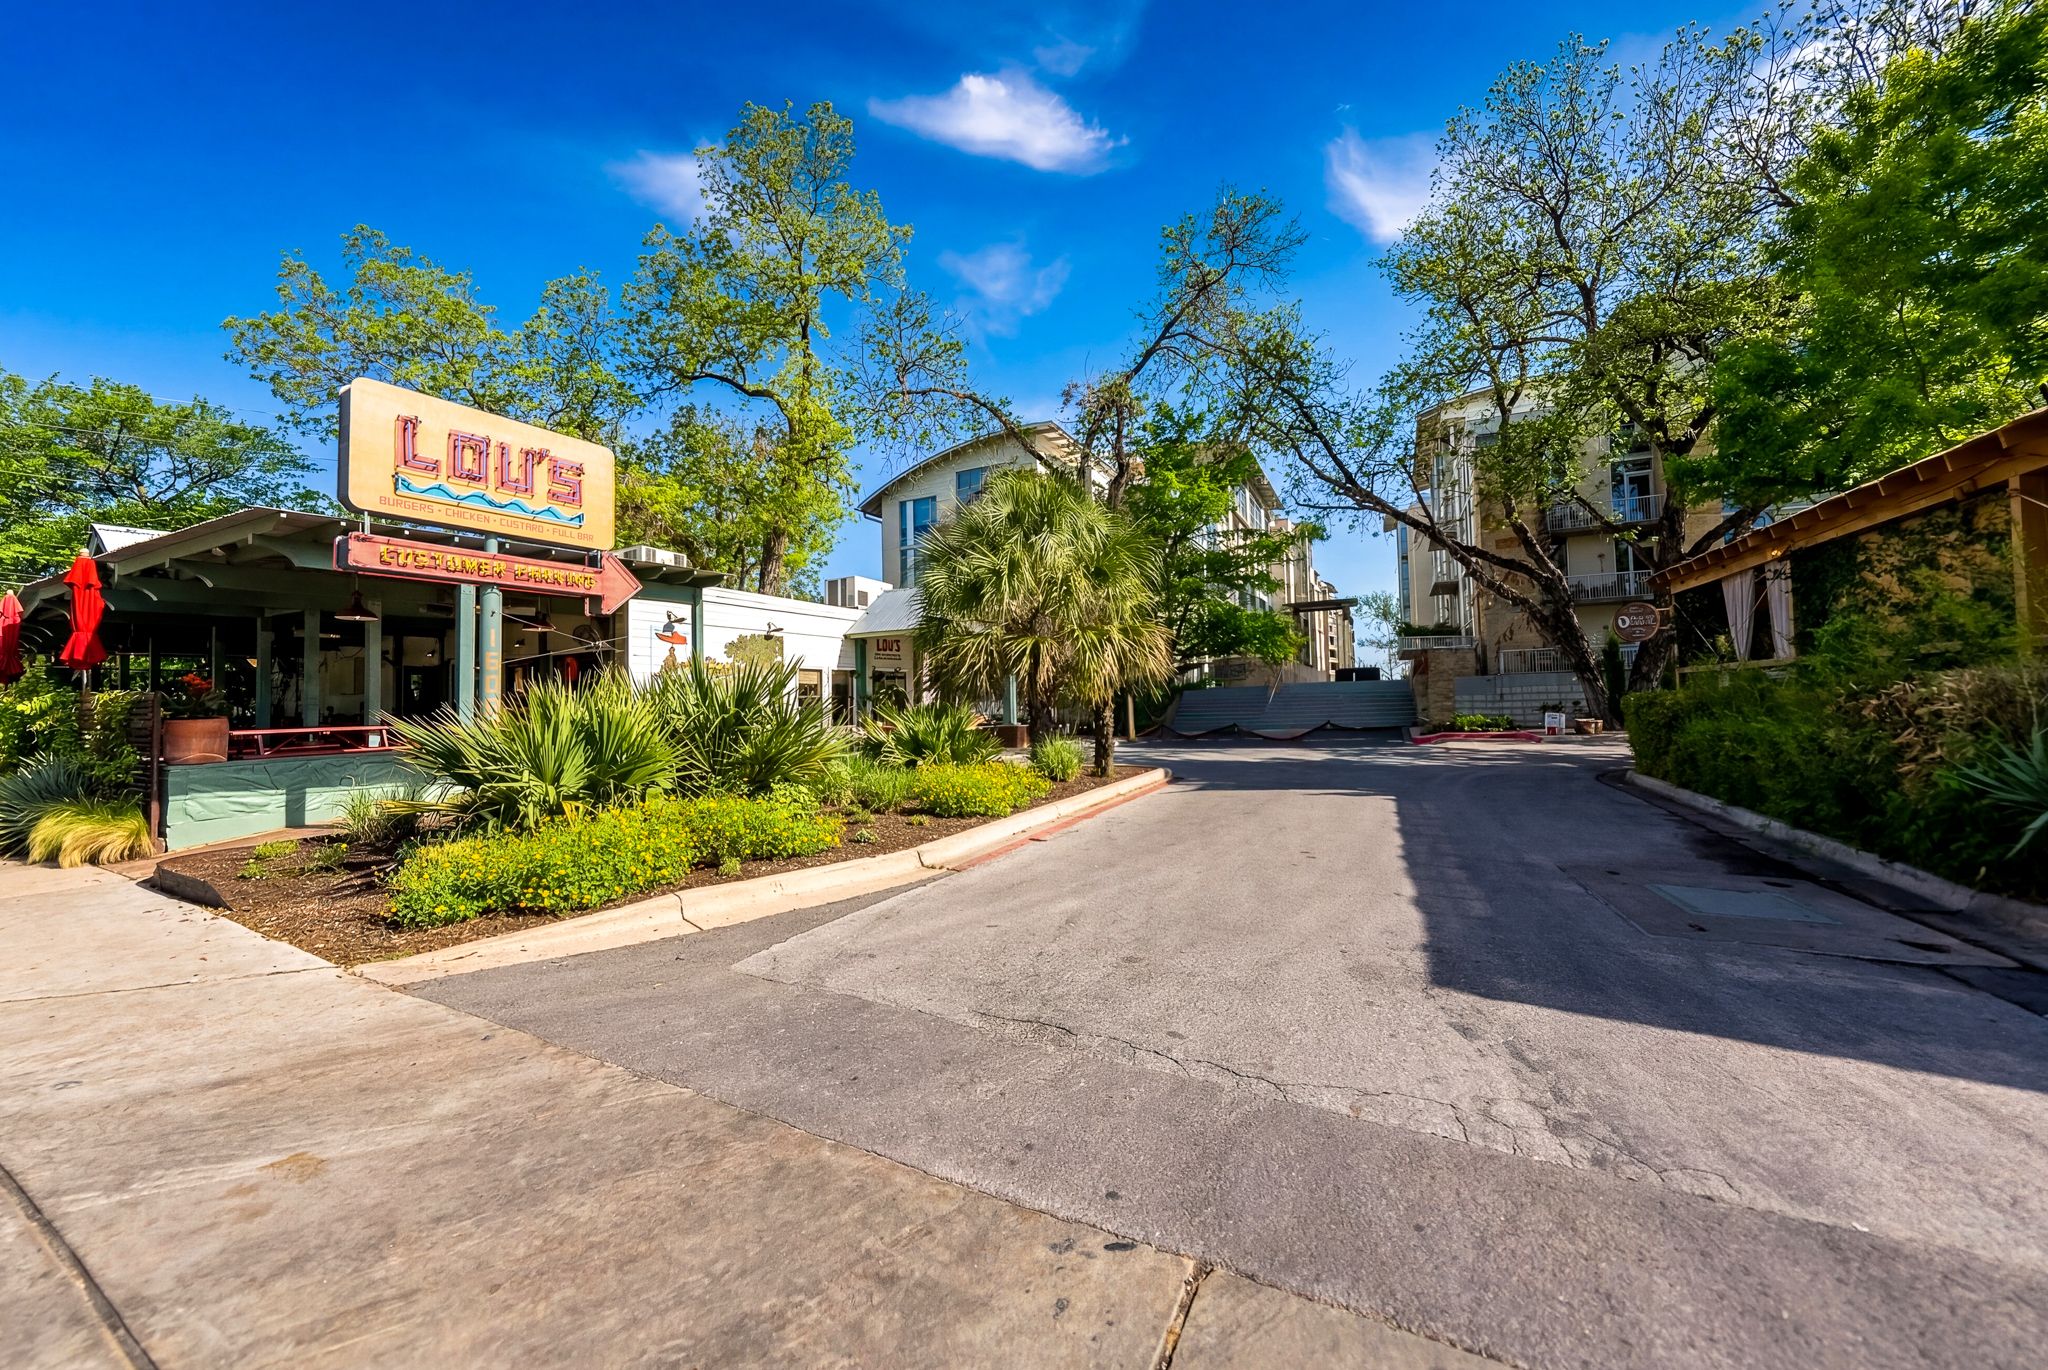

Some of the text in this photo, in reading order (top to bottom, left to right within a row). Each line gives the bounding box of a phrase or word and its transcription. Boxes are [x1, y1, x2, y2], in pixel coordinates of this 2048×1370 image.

[394, 414, 585, 507] LOU'S
[379, 496, 594, 543] BURGERS CHICKEN CUSTARD FULL BAR
[379, 545, 597, 590] CUSTOMER PARKING
[876, 638, 901, 652] LOU'S
